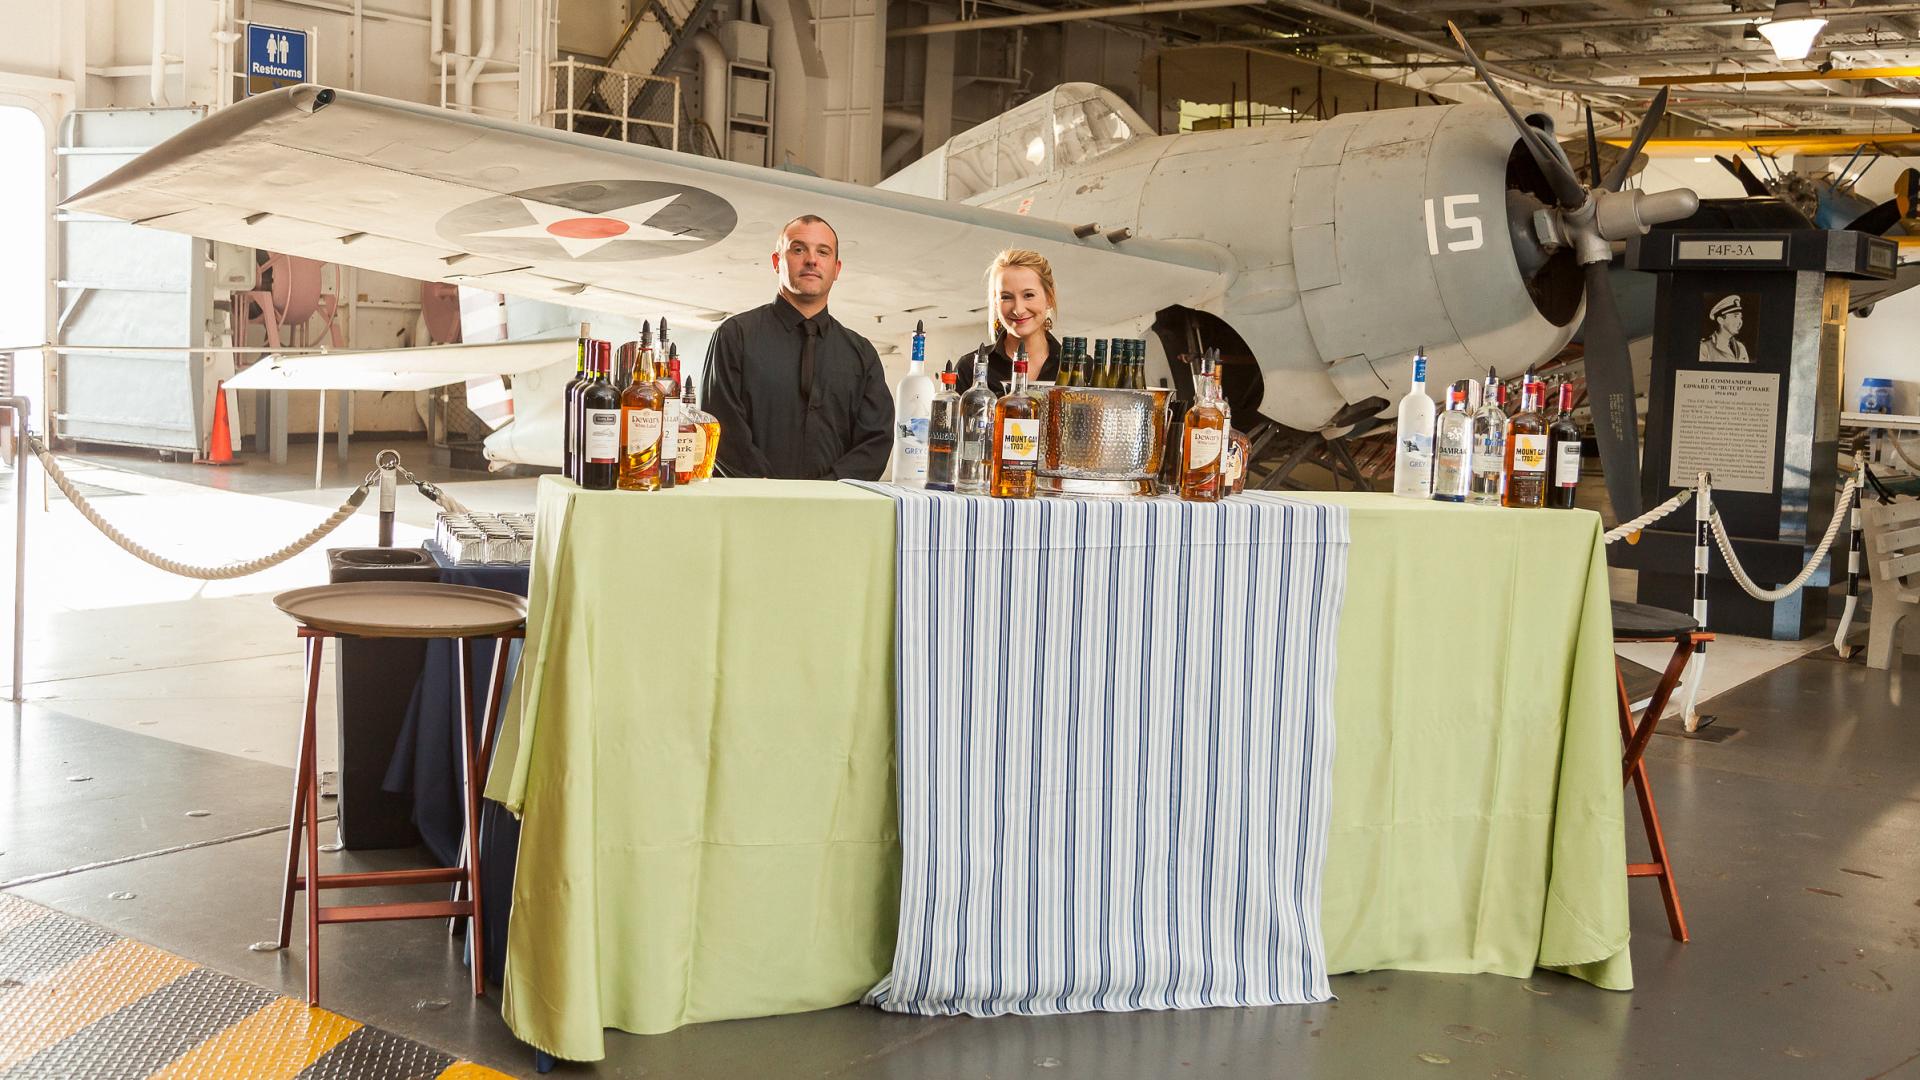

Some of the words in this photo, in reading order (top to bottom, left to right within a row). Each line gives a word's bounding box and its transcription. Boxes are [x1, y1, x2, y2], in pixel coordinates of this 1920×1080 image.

[252, 62, 303, 79] Restrooms
[1424, 194, 1484, 255] 15
[1707, 244, 1755, 256] F4F-3A
[904, 447, 923, 455] GREY
[1515, 448, 1537, 456] MOUNT
[1409, 460, 1426, 468] GREY
